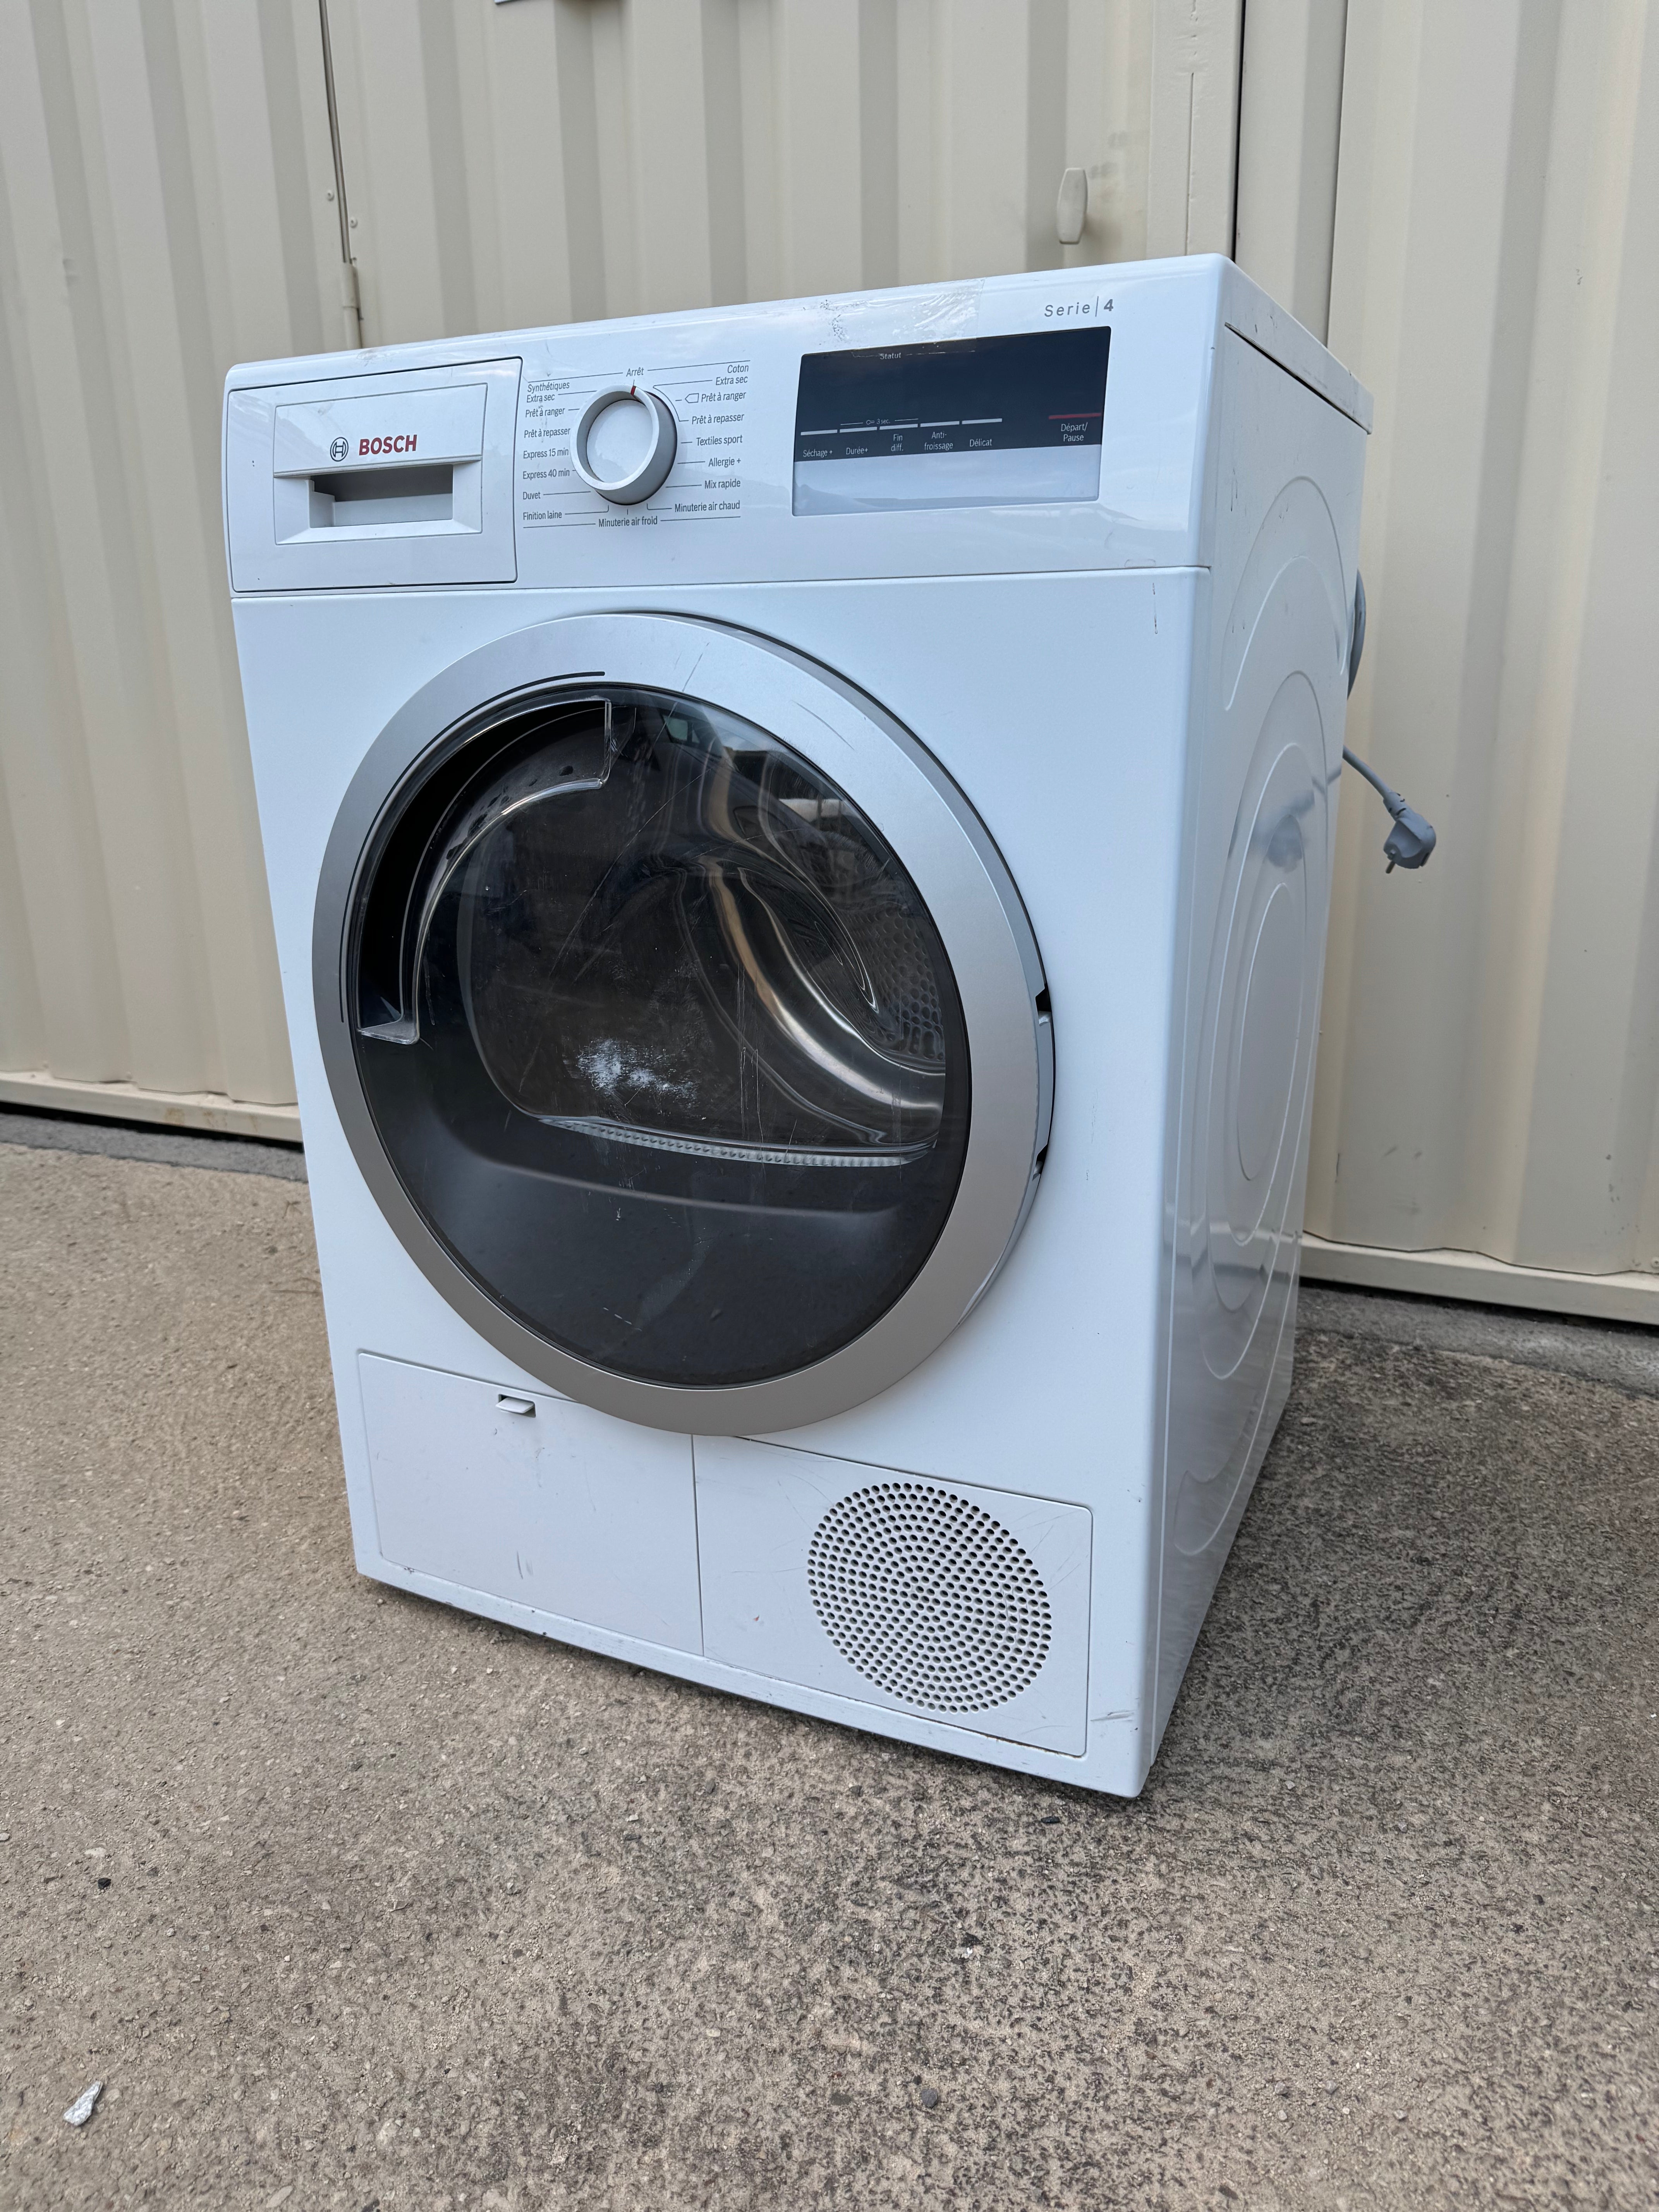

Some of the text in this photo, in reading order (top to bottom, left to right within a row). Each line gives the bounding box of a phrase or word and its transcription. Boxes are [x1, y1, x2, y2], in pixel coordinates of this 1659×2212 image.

[1044, 299, 1113, 317] Serie 4
[626, 367, 644, 376] Arrêt
[727, 364, 749, 373] Coton
[716, 377, 734, 385] Extra
[527, 382, 570, 394] Synthétiques
[527, 395, 543, 403] Extra
[701, 392, 746, 402] Prêt à ranger
[526, 408, 565, 417] Prêt à ranger
[692, 414, 745, 424] Prêt à repasser
[1061, 422, 1088, 433] Départ/
[524, 428, 570, 438] Prêt à repasser
[359, 434, 417, 456] BOSCH
[696, 434, 743, 446] Textiles sport
[970, 438, 992, 447] Délicat
[891, 443, 903, 452] diff.
[924, 442, 953, 451] froissage
[523, 447, 569, 460] Express 15 min
[803, 449, 828, 458] Séchage
[708, 457, 735, 467] Allergie
[523, 468, 570, 480] Express 40 min
[705, 478, 740, 489] Mix rapide
[523, 491, 541, 500] Duvet
[675, 500, 740, 512] Minuterie air chaud
[523, 510, 562, 520] Finition laine
[599, 515, 658, 527] Minuterie air froid
